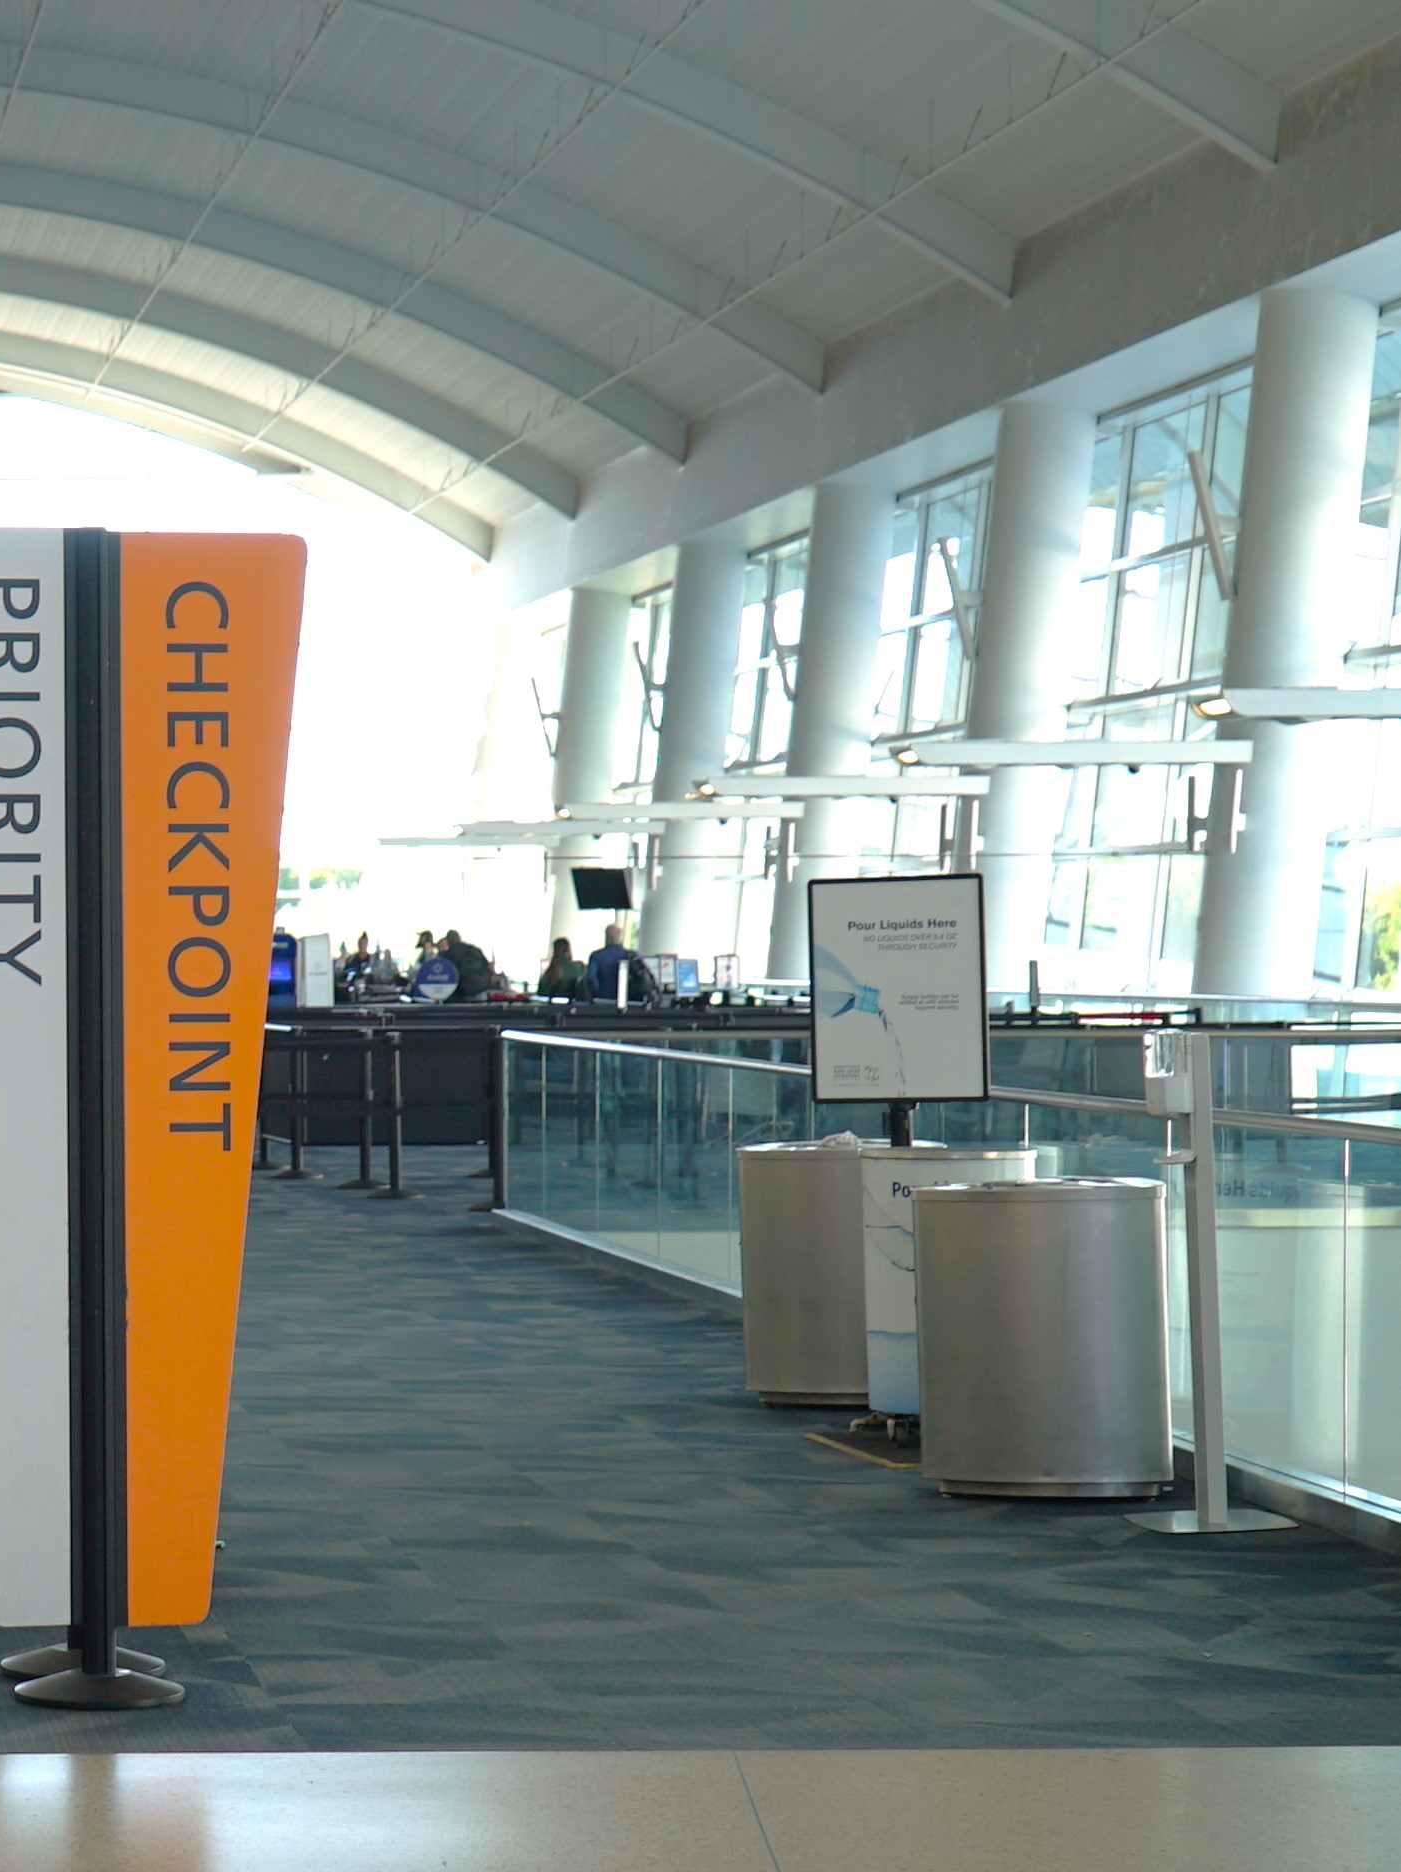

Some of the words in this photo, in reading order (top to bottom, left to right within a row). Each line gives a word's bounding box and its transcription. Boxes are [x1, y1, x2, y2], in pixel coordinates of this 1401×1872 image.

[165, 581, 231, 1151] CHECKPOINT
[847, 920, 876, 931] Pour
[880, 919, 924, 931] Liquids
[927, 918, 957, 928] Here
[891, 1181, 913, 1198] Po
